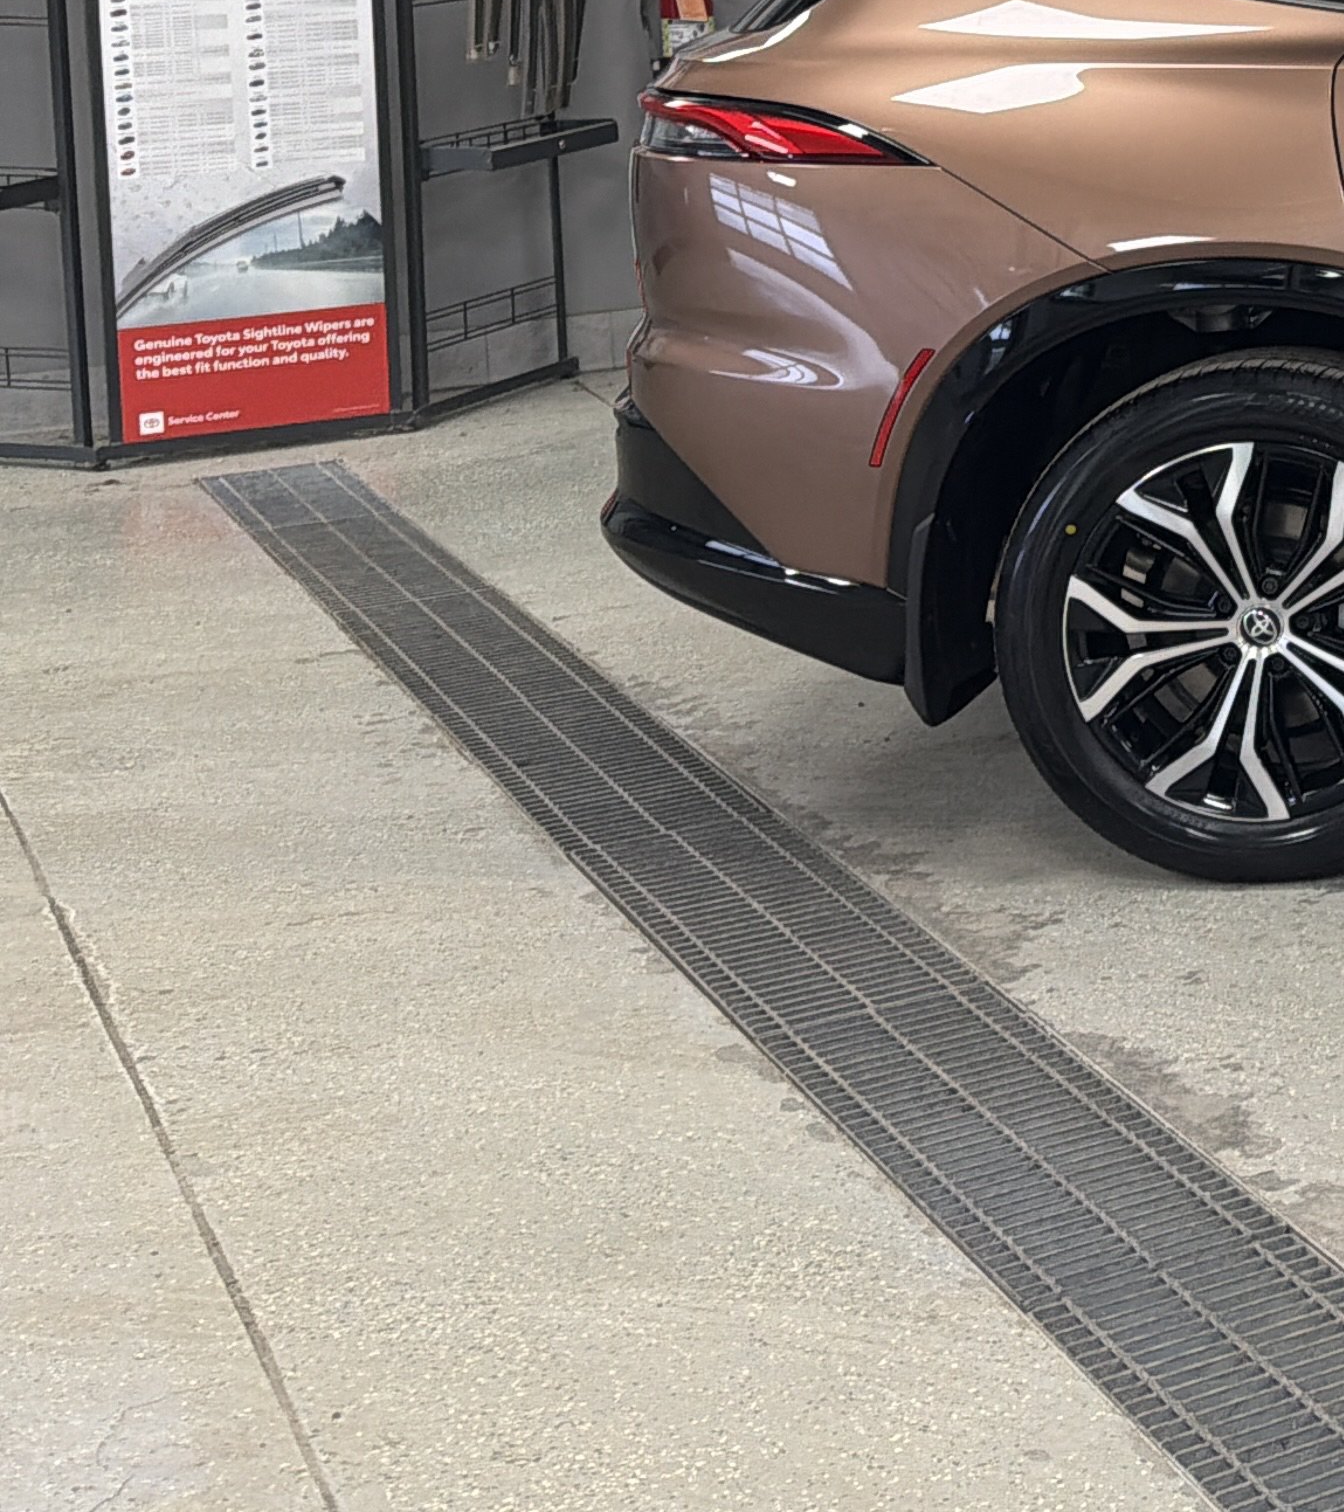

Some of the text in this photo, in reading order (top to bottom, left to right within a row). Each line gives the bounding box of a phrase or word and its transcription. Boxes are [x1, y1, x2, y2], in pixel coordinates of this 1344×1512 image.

[134, 317, 375, 352] Genuine Toyota Sightline Wipers are
[134, 331, 371, 368] engineered for your Toyota offering
[135, 347, 350, 381] the best fit function and quality.
[167, 410, 241, 427] Service Center
